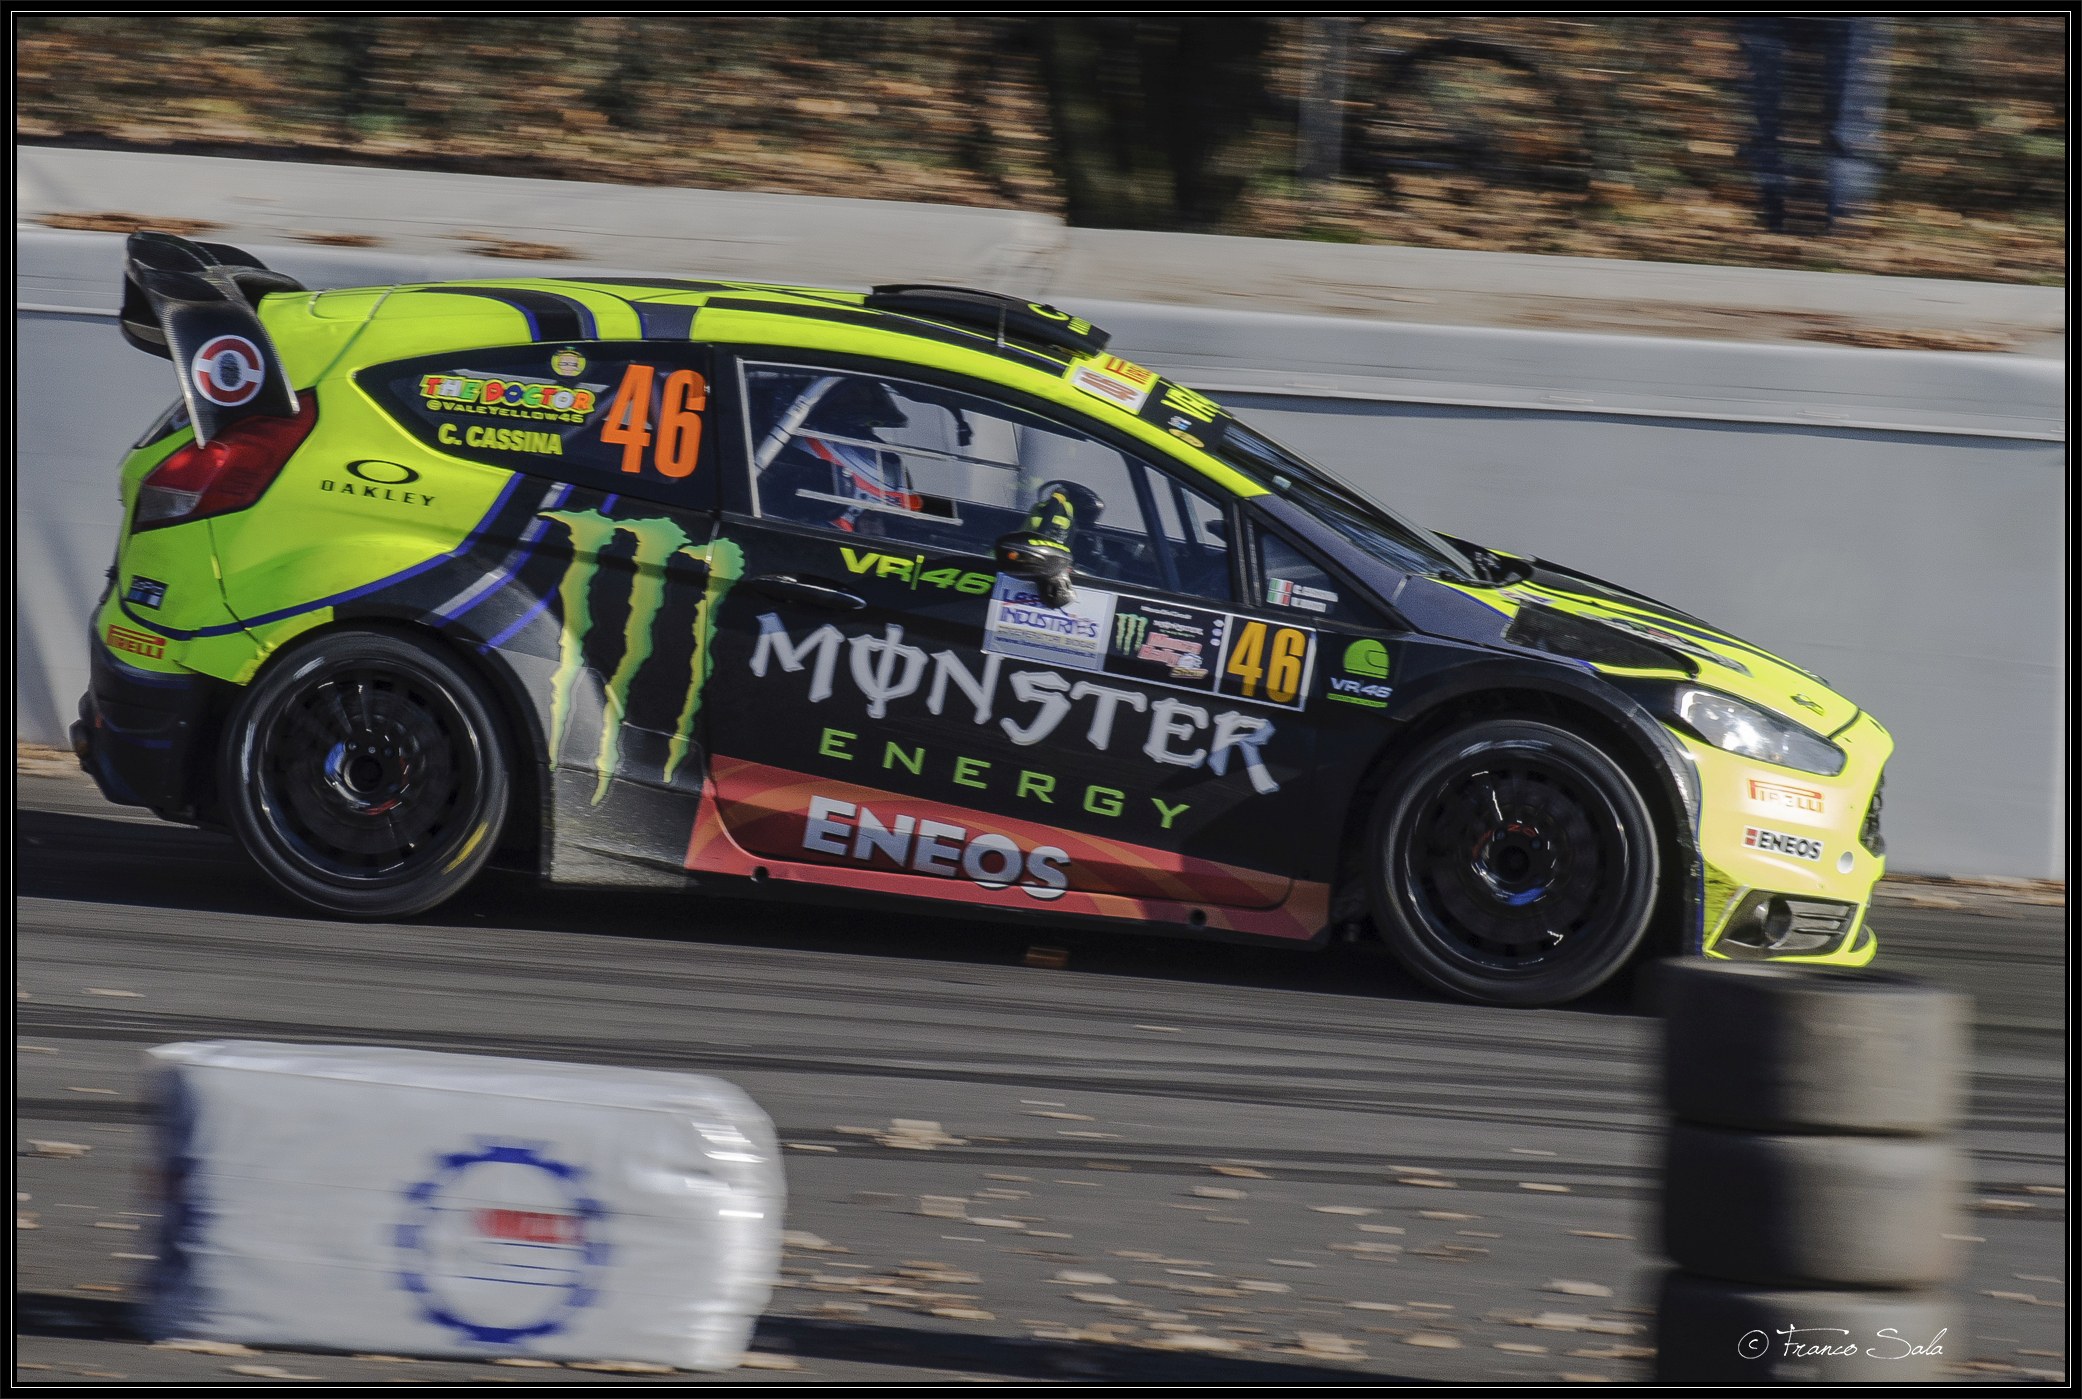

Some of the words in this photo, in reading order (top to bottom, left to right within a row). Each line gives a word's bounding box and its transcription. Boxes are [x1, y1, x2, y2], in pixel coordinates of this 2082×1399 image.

[424, 376, 480, 401] THE
[484, 380, 593, 411] DOCTOR
[600, 363, 707, 478] 46
[438, 423, 462, 446] C.
[466, 426, 563, 455] CASSINA
[320, 479, 437, 507] OAKLEY
[1226, 620, 1306, 703] 46
[749, 612, 1279, 793] MONSTER
[819, 728, 1190, 828] ENERGY
[1746, 779, 1824, 813] PIRELLI
[801, 795, 1070, 899] ENEOS
[1758, 830, 1821, 860] ENEOS
